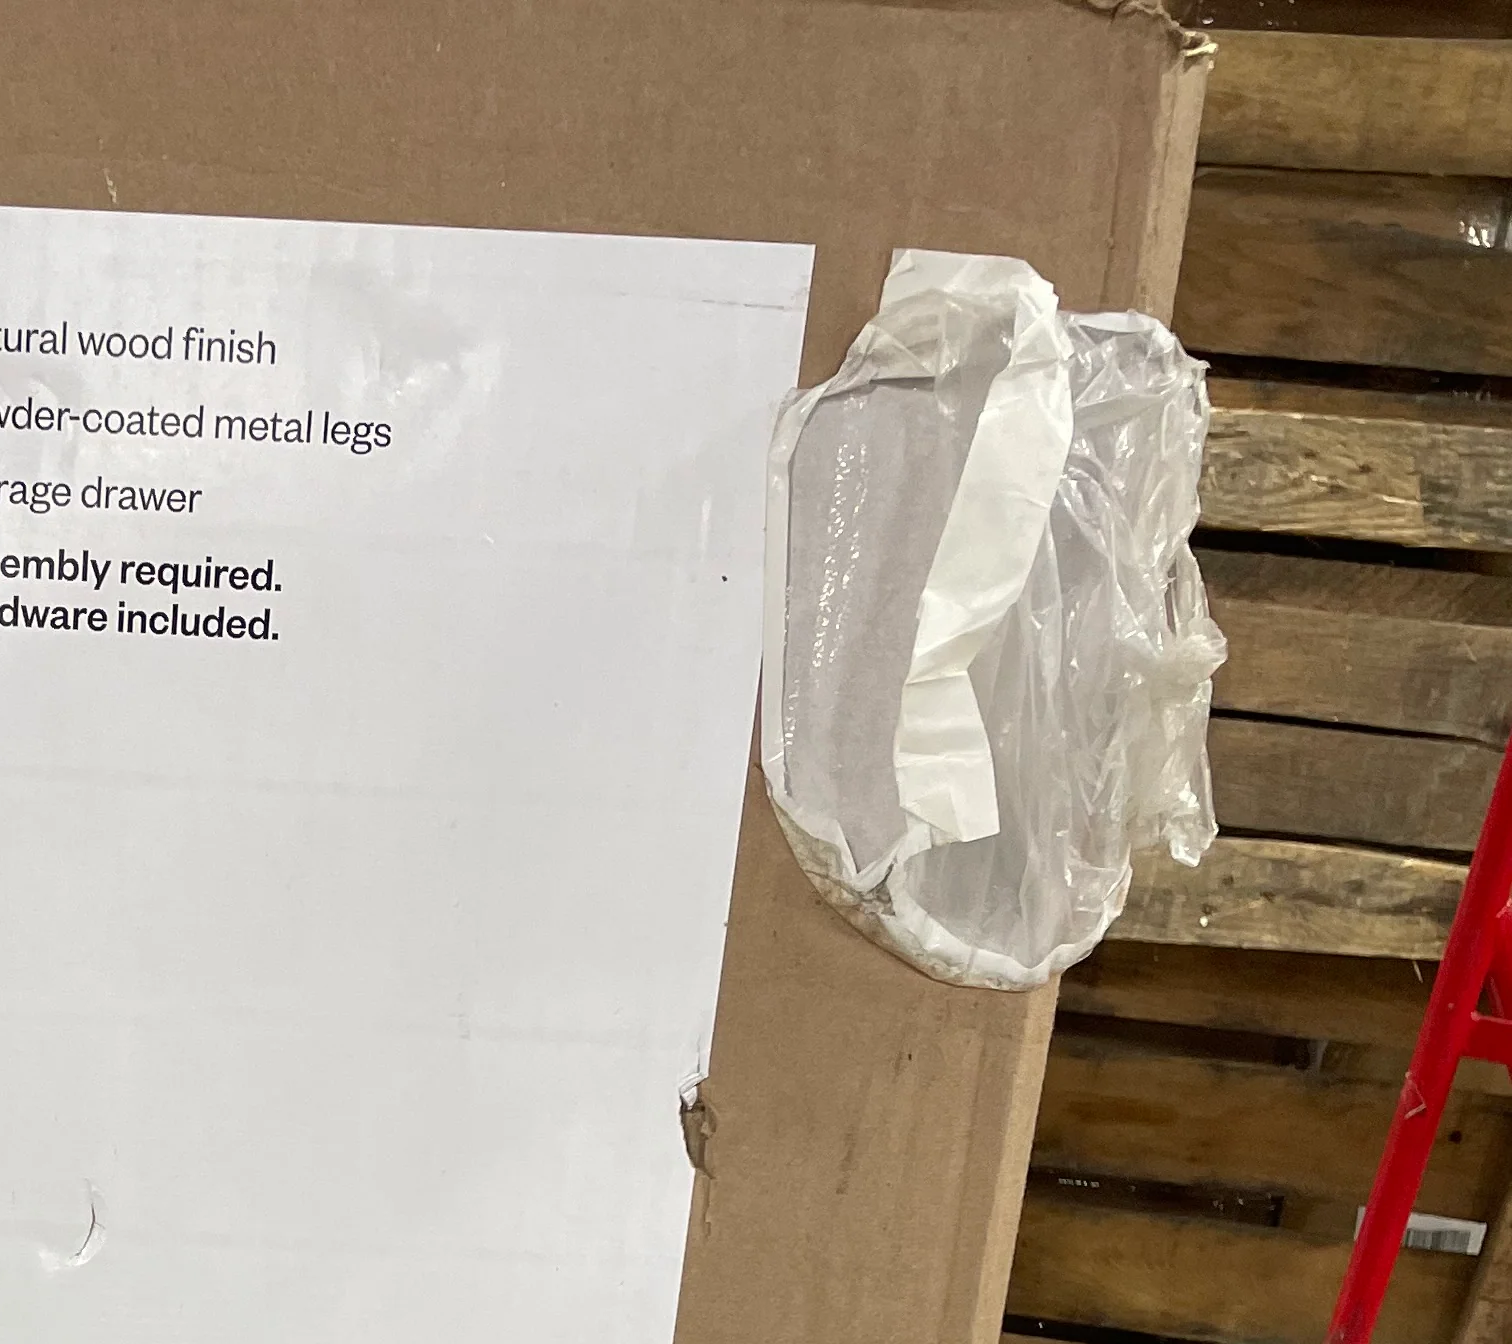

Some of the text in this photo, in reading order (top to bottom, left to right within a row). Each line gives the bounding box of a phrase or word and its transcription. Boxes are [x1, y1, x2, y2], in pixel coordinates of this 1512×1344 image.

[78, 327, 173, 359] wood
[183, 327, 277, 364] finish
[215, 411, 312, 443] metal
[323, 412, 392, 454] legs
[82, 477, 202, 512] drawer
[120, 557, 282, 593] required.
[117, 601, 279, 640] included.
